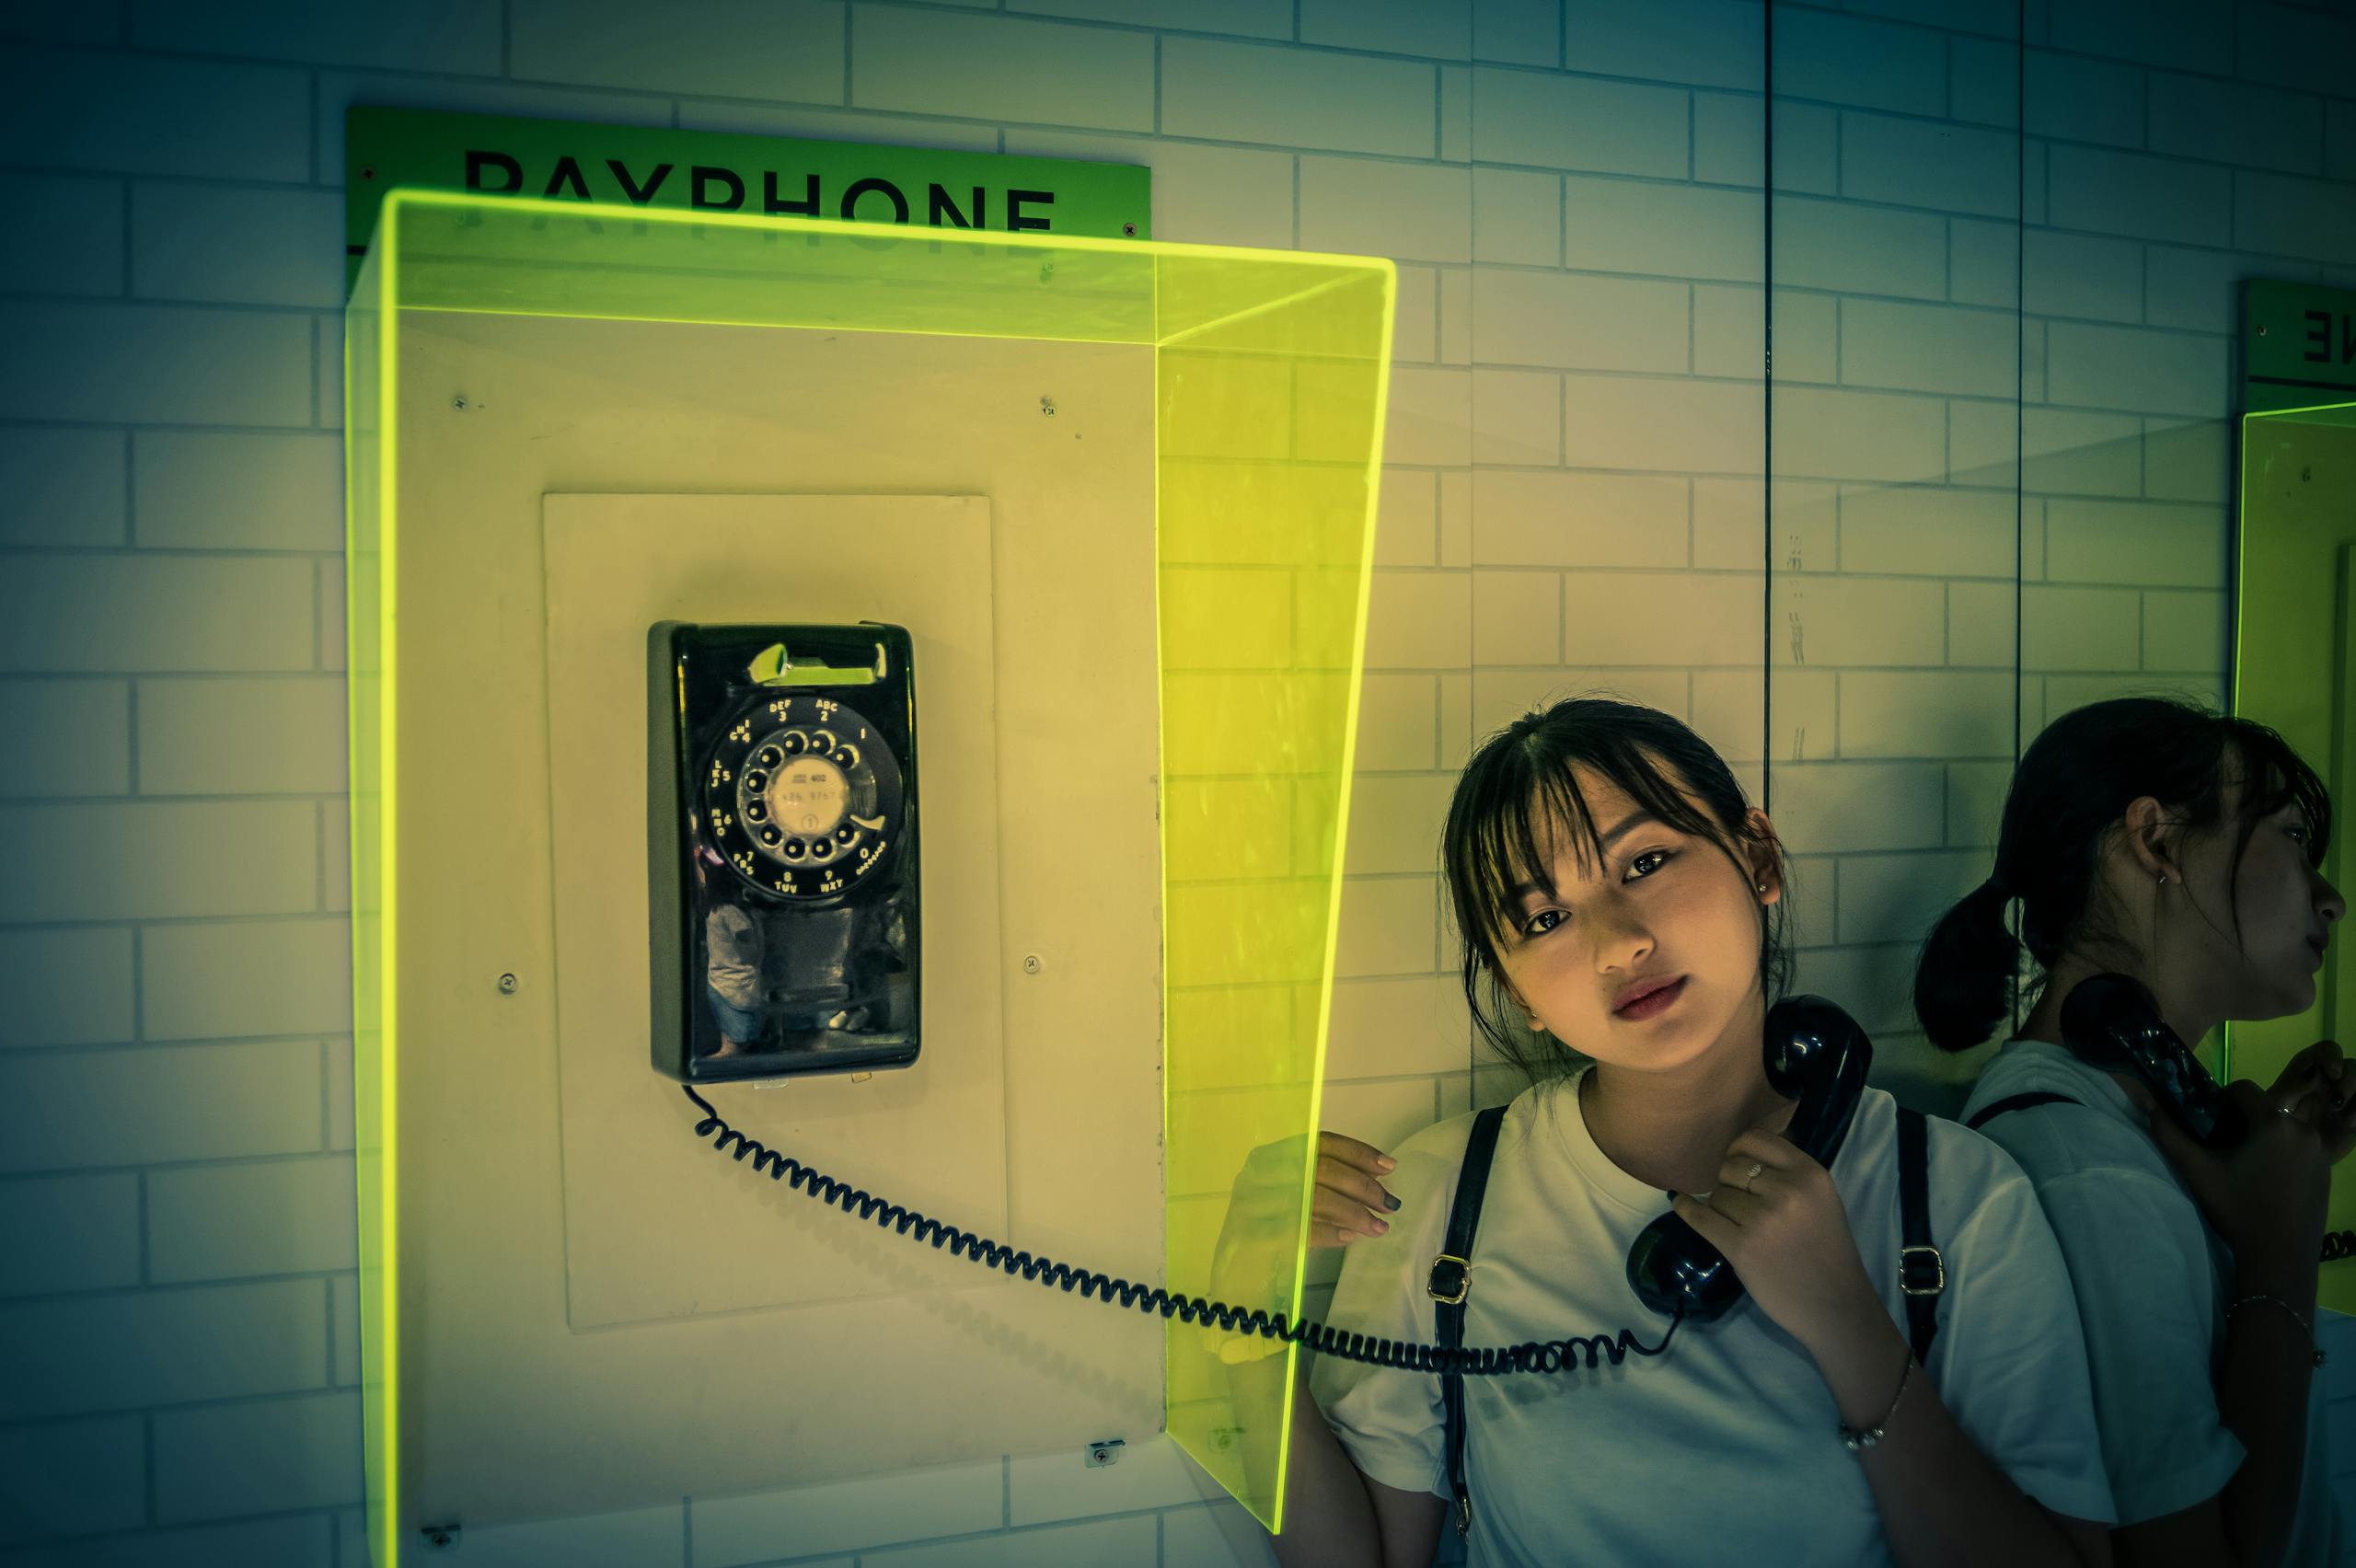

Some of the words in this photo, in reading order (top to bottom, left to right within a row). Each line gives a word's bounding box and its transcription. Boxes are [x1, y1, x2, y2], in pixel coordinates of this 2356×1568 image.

[464, 149, 1056, 258] PAYPHONE
[769, 699, 791, 713] DEF
[815, 699, 838, 712] ABC
[779, 710, 787, 721] 3
[820, 710, 828, 721] 2
[742, 732, 751, 743] 4
[722, 770, 731, 781] 5
[723, 814, 732, 824] 6
[747, 851, 754, 861] 7
[783, 871, 791, 882] 8
[825, 870, 833, 881] 9
[774, 882, 798, 894] TUV
[820, 879, 843, 893] WXY
